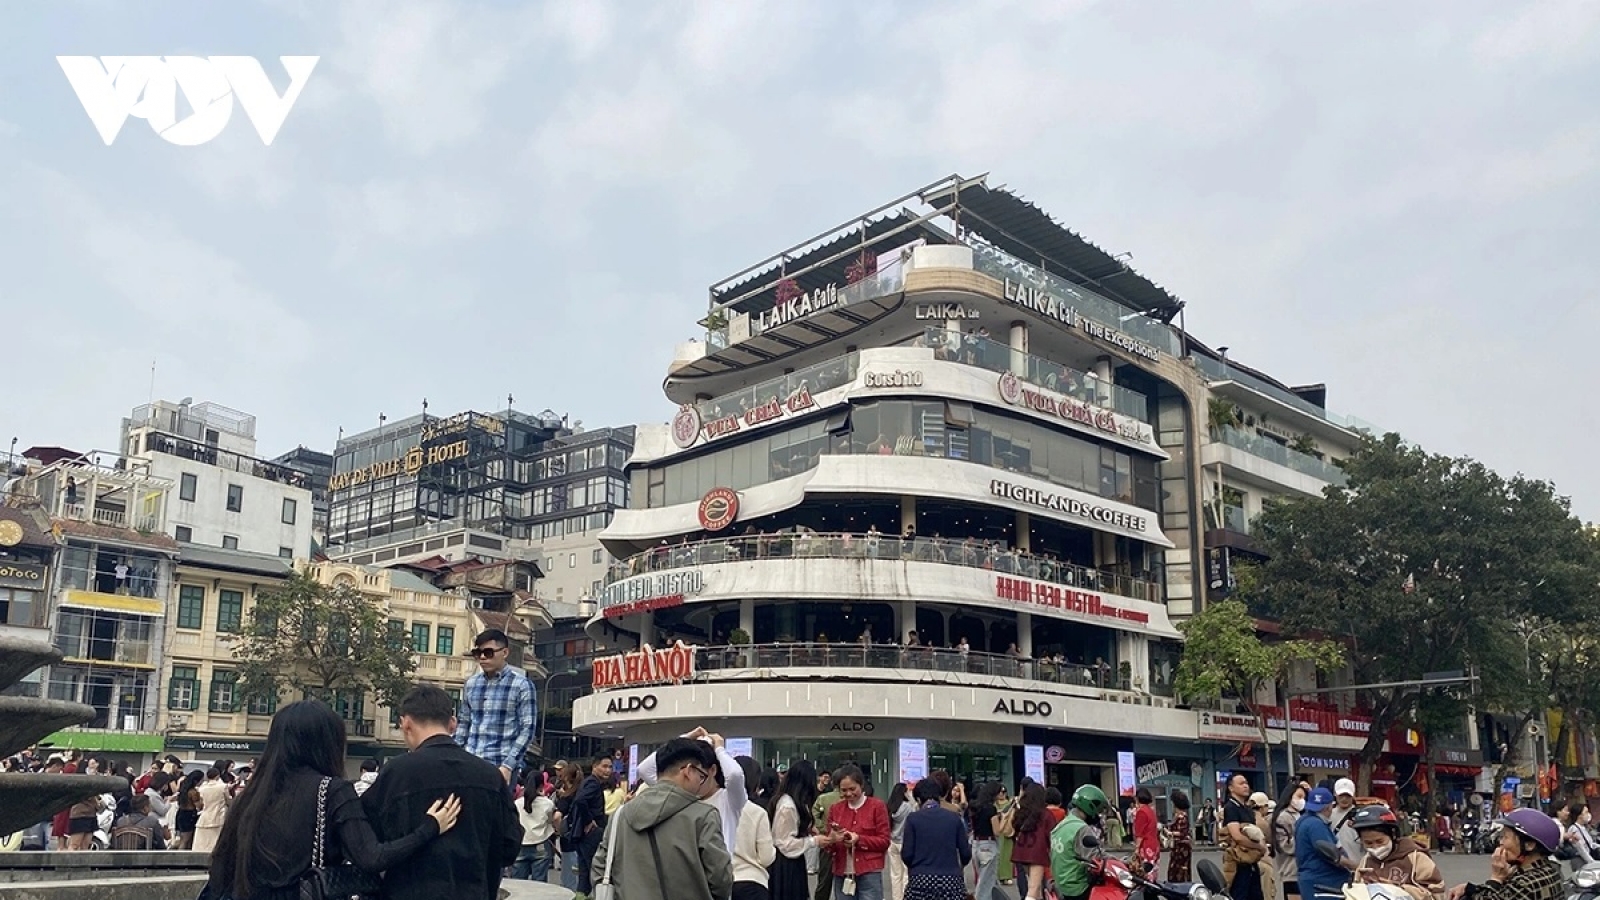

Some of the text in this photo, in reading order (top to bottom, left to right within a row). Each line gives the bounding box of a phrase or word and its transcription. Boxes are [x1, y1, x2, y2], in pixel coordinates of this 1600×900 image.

[760, 282, 837, 331] LAIKA Café
[915, 304, 966, 319] LAIKA
[1004, 277, 1059, 320] LAIKA
[1083, 318, 1103, 337] The
[1104, 327, 1161, 362] Exceptional
[1022, 389, 1057, 415] VUA
[1095, 410, 1118, 434] CÁ
[704, 414, 740, 439] VUA
[328, 440, 469, 492] MAY DE VILLE HOTEL
[992, 480, 1146, 532] HIGHLANDS COFFEE
[656, 569, 704, 596] BISTRO
[1035, 583, 1061, 608] 1930
[592, 640, 695, 689] BIA HÀ NỘI
[607, 694, 657, 714] ALDO
[993, 699, 1052, 716] ALDO
[830, 722, 875, 732] ALDO
[200, 741, 249, 750] Vietcombank
